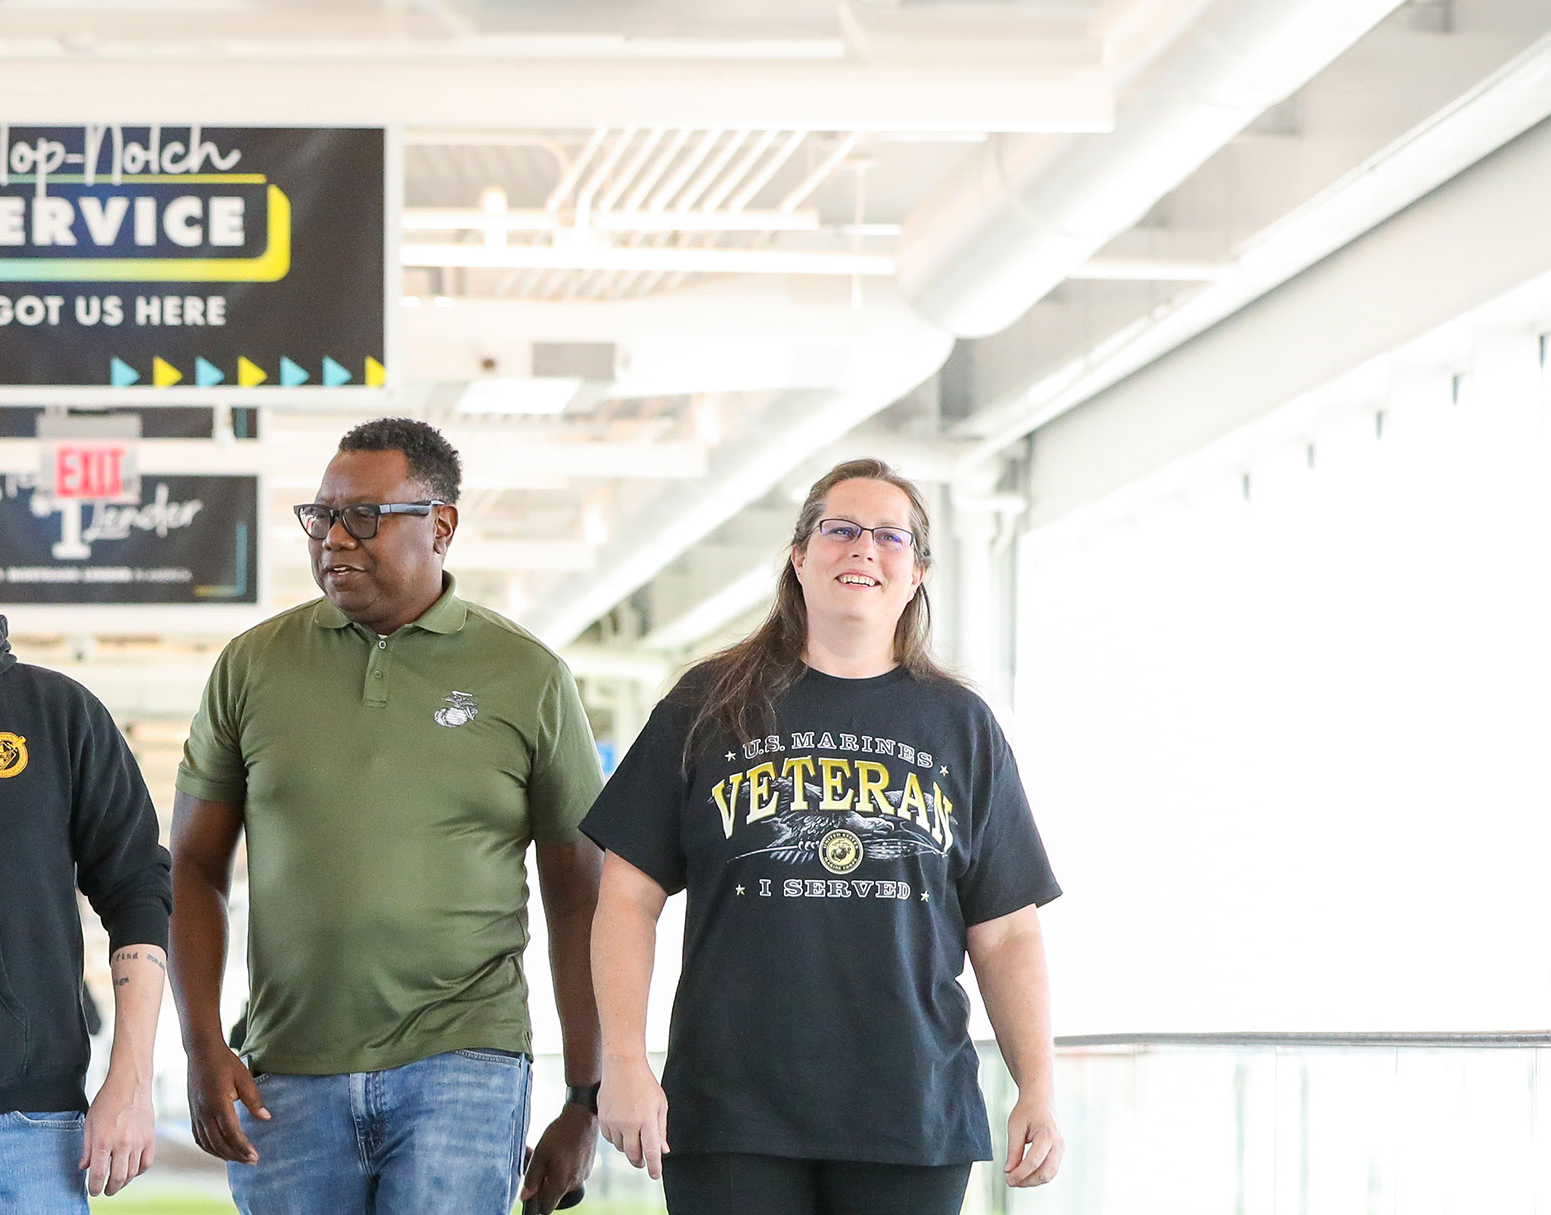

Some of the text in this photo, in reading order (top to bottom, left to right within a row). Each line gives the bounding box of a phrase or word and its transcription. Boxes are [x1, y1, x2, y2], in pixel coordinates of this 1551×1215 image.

[75, 295, 125, 326] US
[135, 295, 227, 326] HERE
[54, 446, 127, 499] EXIT
[742, 731, 934, 768] U.S. MARINES
[710, 755, 954, 855] VETERAN
[758, 879, 911, 899] I SERVED
